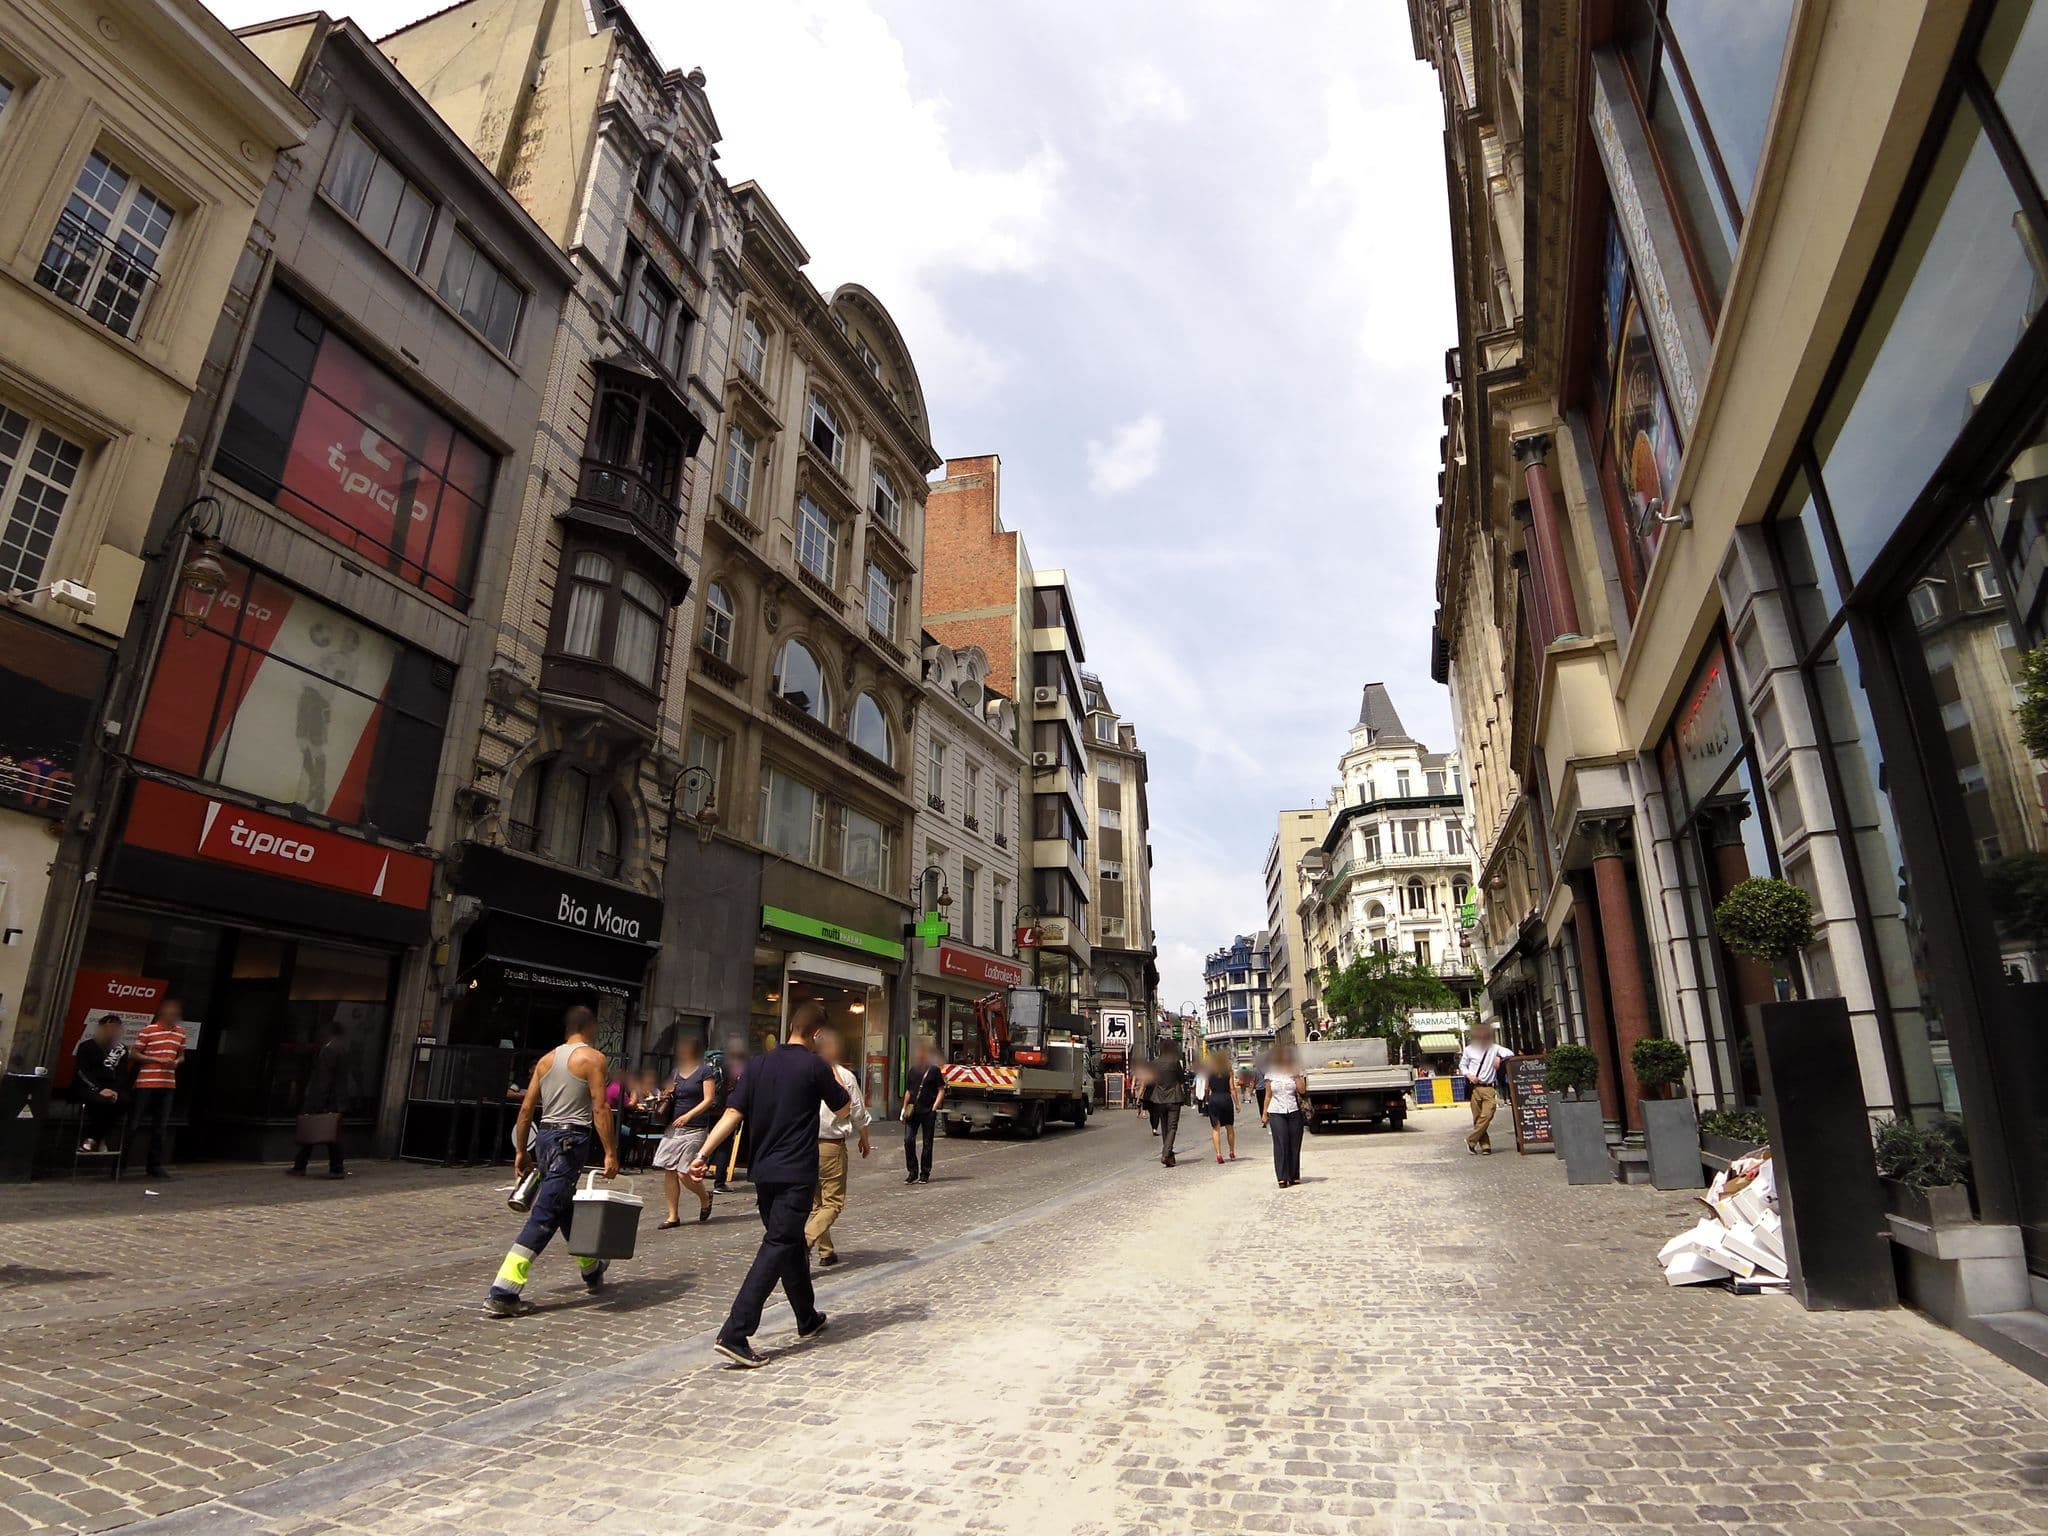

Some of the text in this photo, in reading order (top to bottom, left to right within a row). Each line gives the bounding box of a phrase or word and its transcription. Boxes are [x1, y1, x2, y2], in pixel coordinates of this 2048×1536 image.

[230, 819, 315, 863] tipico
[558, 893, 640, 938] Bia Mara
[503, 968, 529, 981] Fresh
[107, 979, 156, 998] tipico
[1409, 1016, 1458, 1026] PHARMACIE
